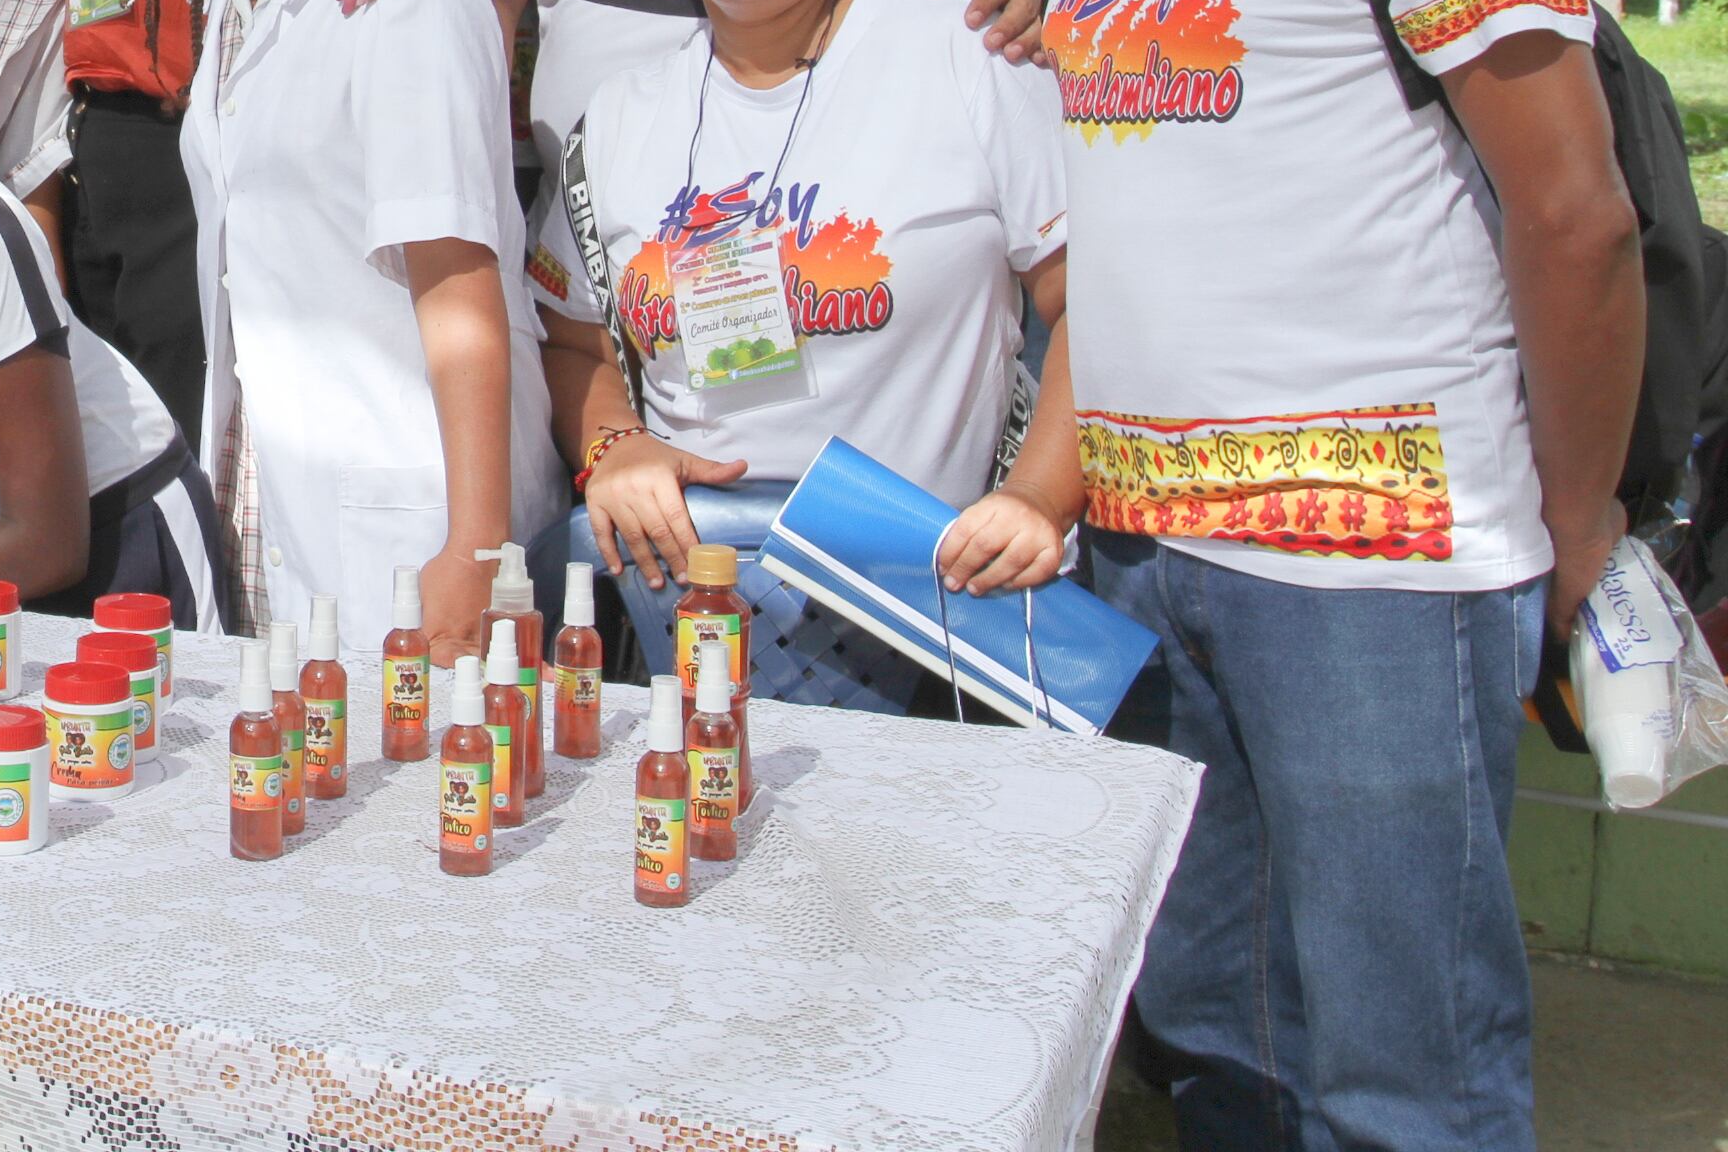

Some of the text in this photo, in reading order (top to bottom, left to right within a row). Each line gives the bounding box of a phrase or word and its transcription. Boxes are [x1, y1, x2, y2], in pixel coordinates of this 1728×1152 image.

[657, 171, 820, 251] #Soy
[619, 268, 894, 360] Afrobiano
[690, 307, 778, 338] Comité Organizador
